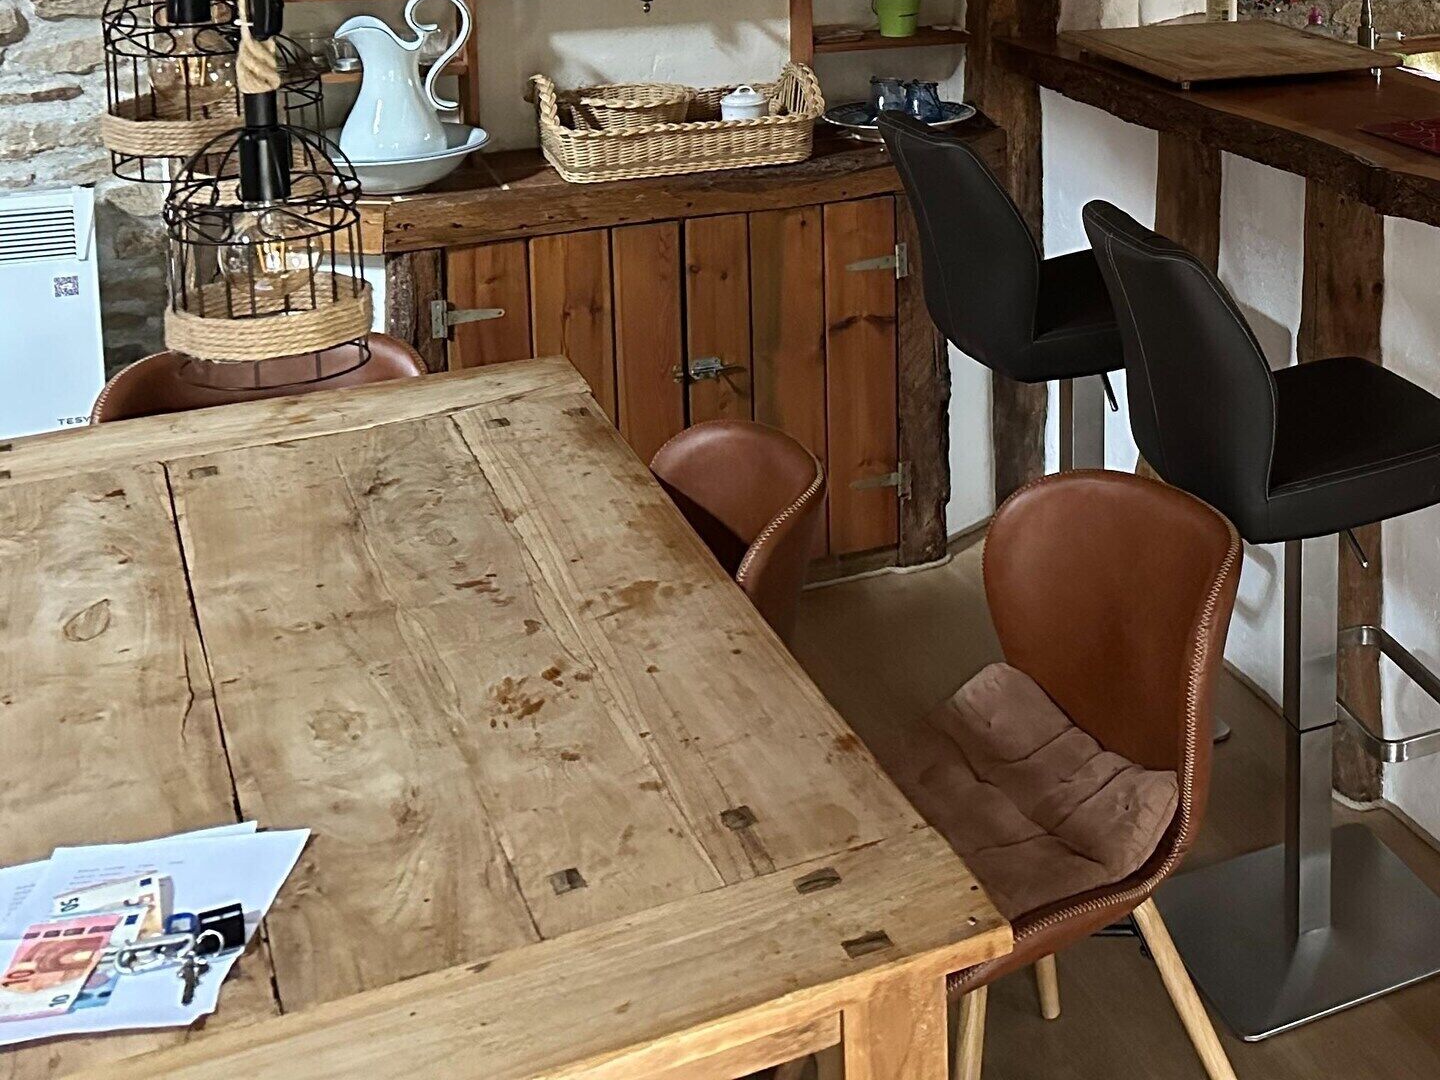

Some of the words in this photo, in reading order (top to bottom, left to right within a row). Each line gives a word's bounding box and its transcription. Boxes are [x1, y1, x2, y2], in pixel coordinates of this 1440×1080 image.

[57, 416, 92, 426] TESY
[59, 897, 79, 913] 50
[2, 970, 35, 987] 10
[48, 994, 70, 1008] 10
